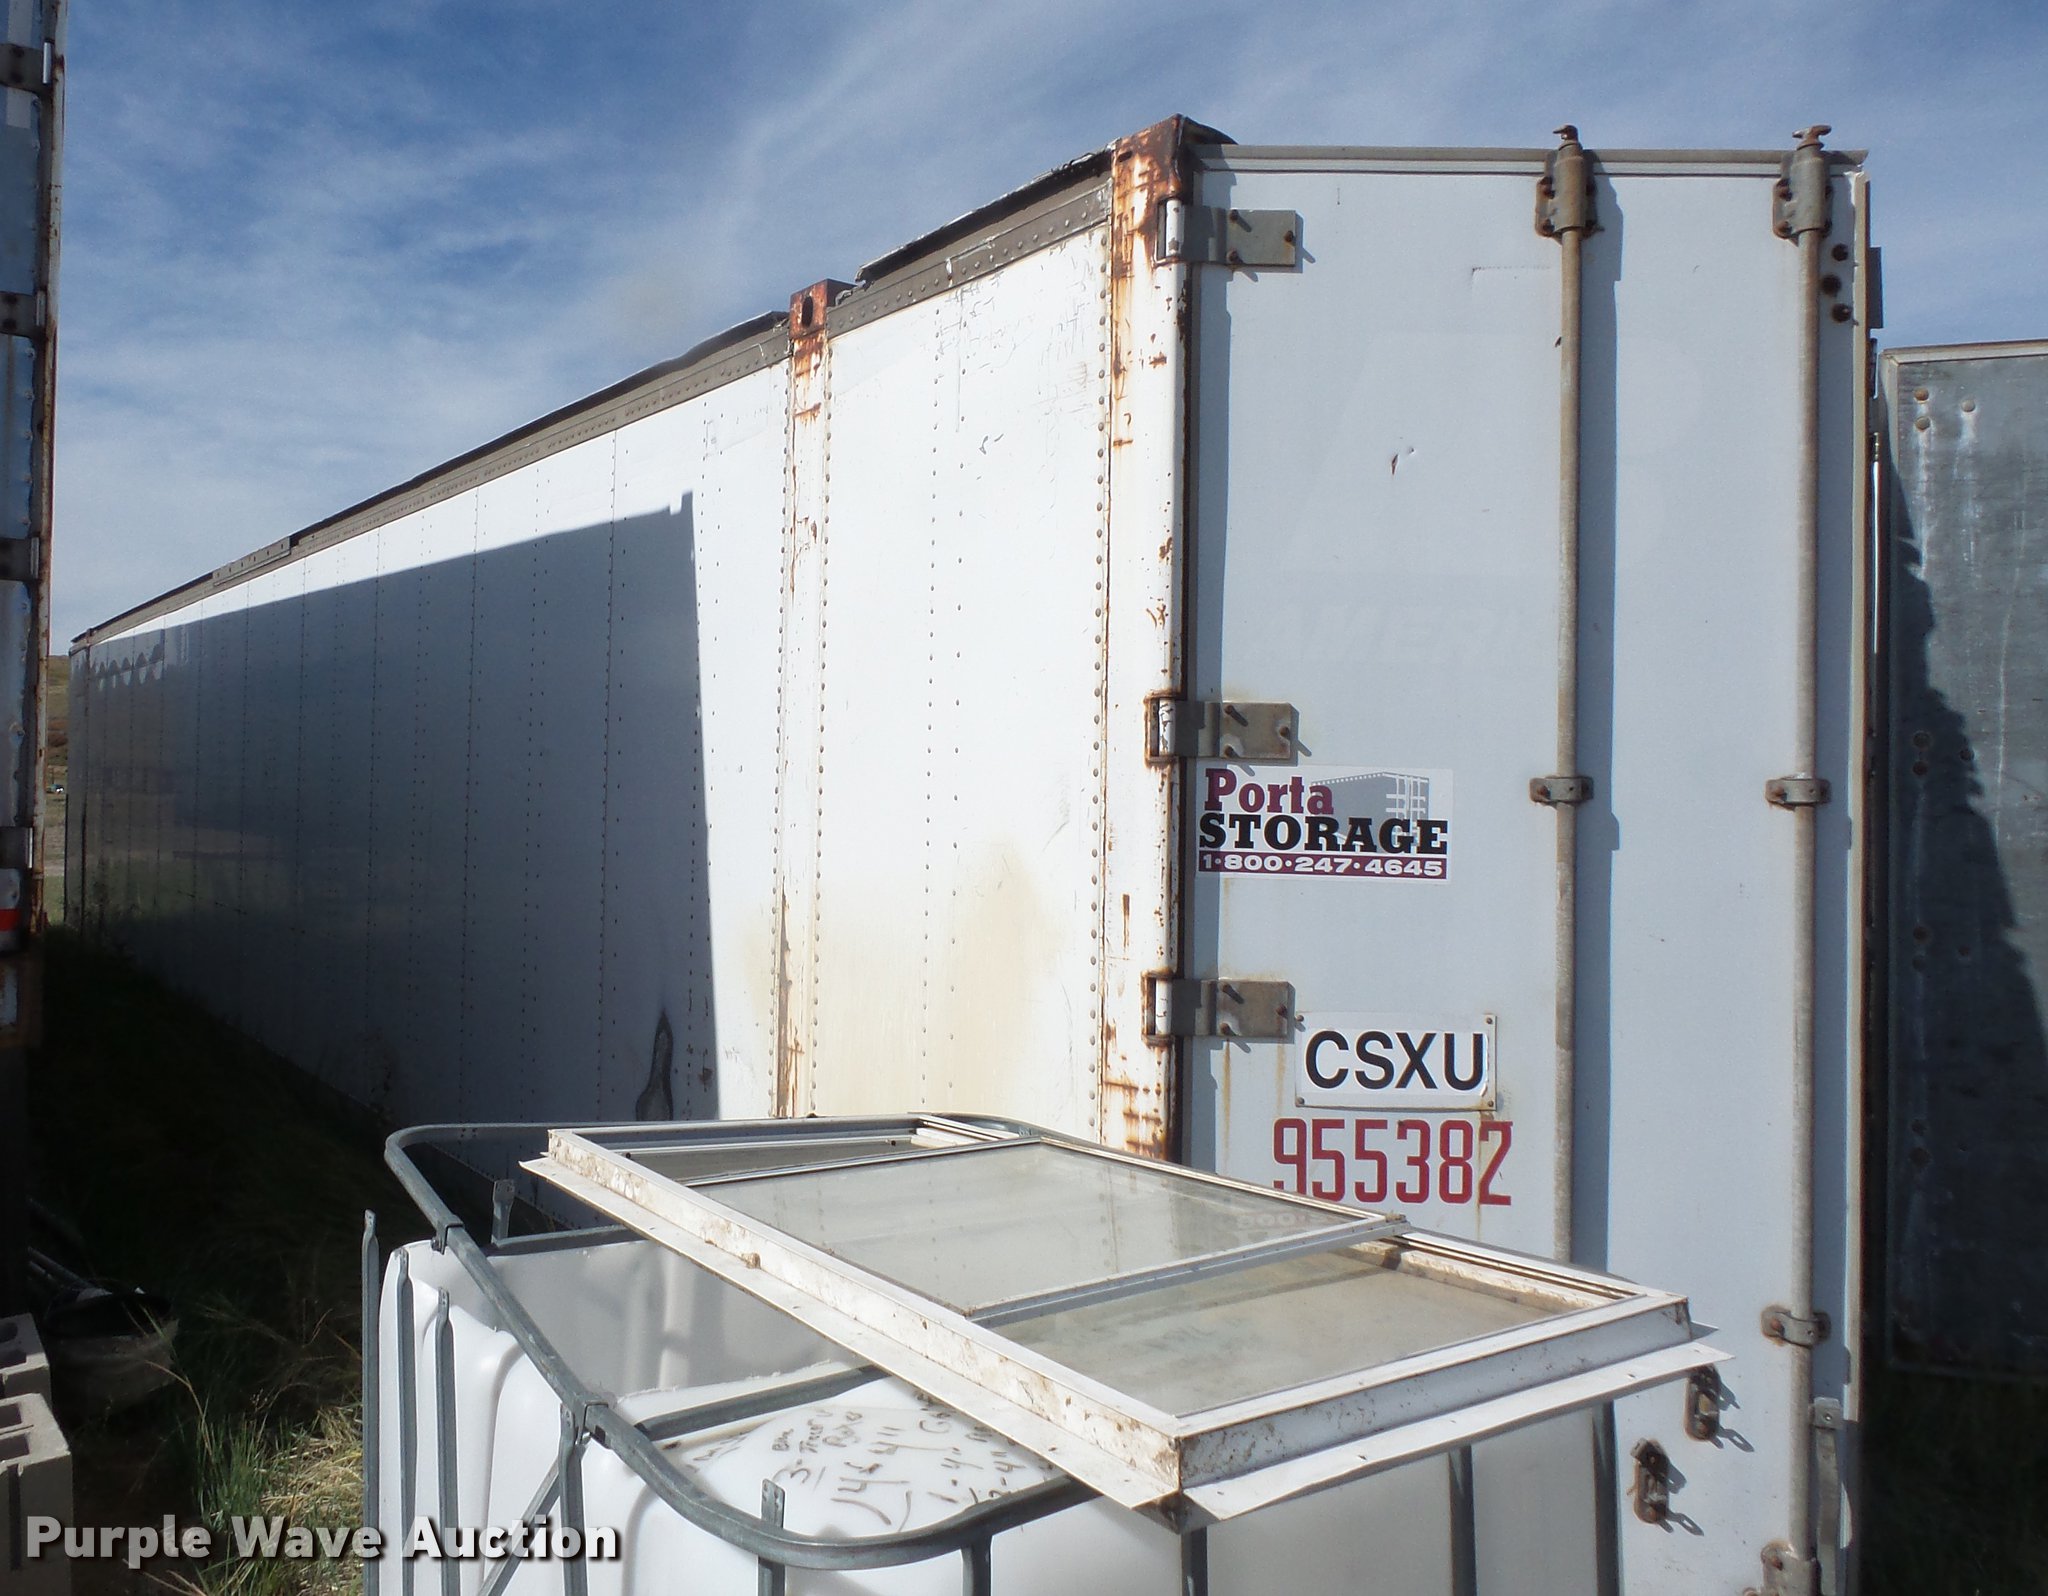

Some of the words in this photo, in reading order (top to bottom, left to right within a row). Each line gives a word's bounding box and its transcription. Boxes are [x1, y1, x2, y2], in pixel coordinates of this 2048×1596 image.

[1204, 768, 1334, 815] Porta
[1199, 812, 1448, 855] STORAGE
[1305, 1030, 1485, 1091] CSXU
[1273, 1118, 1513, 1205] 955382
